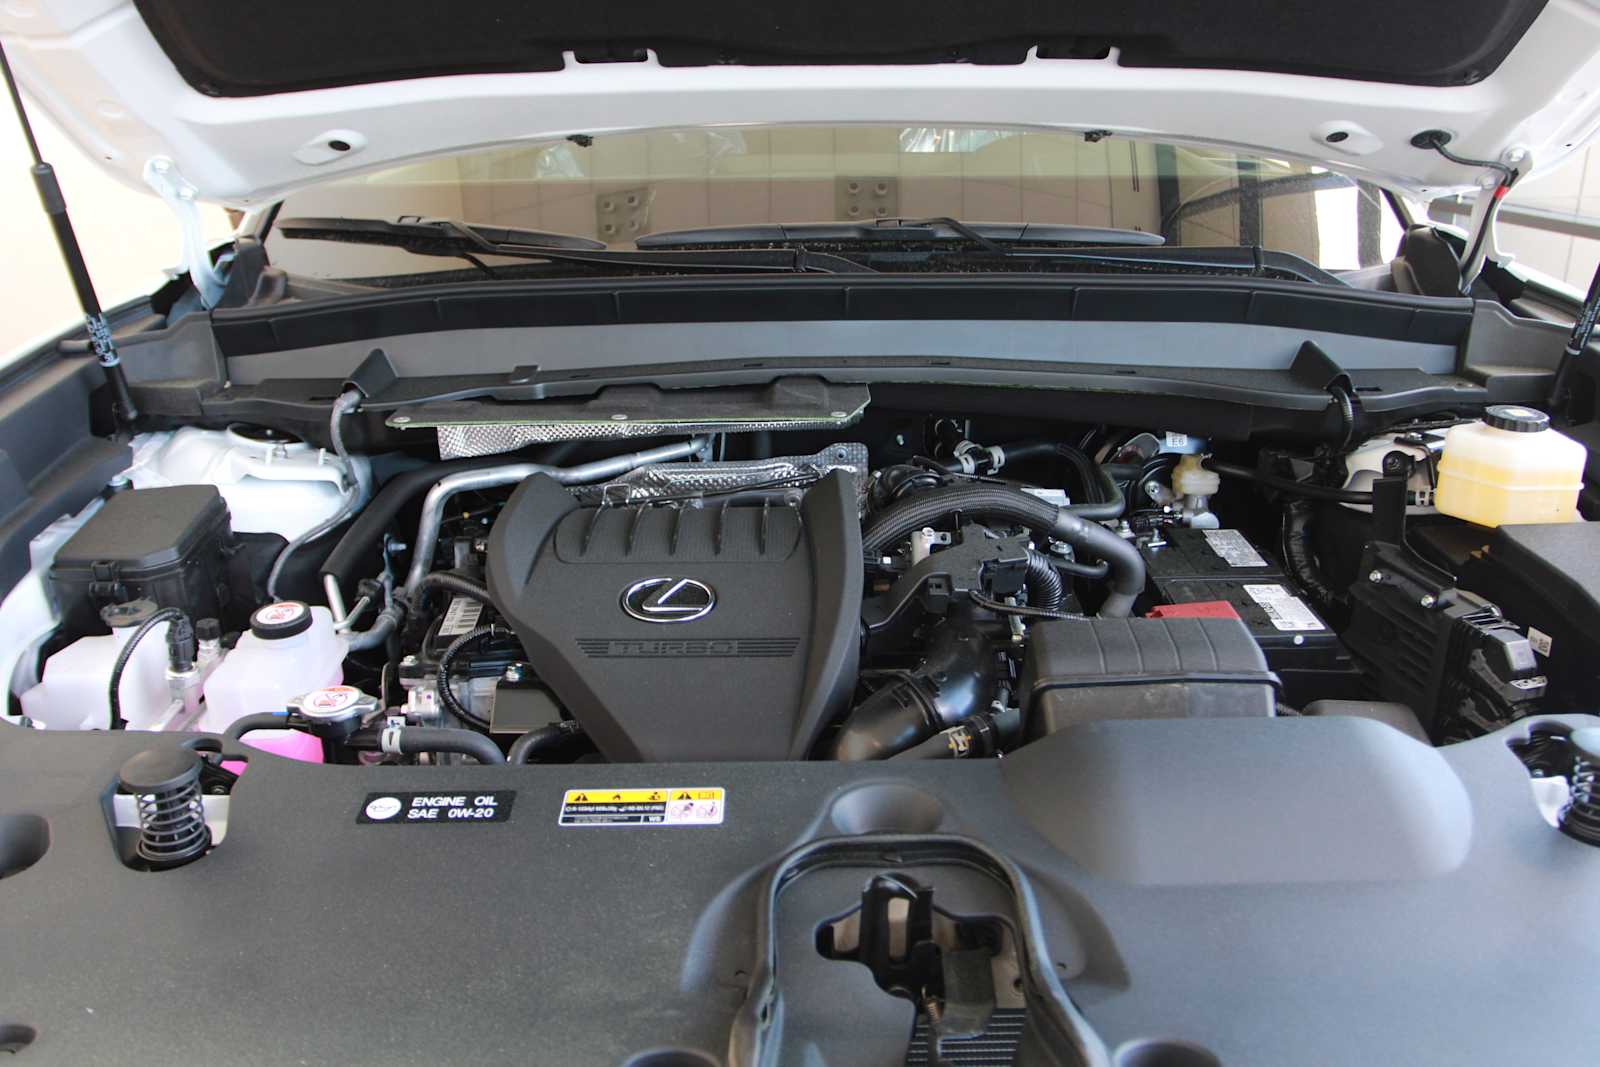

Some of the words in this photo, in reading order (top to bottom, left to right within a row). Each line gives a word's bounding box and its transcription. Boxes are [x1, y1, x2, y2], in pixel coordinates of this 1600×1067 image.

[614, 640, 735, 656] TURBO
[411, 796, 467, 807] ENGINE
[474, 795, 499, 806] OIL
[407, 808, 440, 819] SAE
[448, 807, 495, 819] 0W-20
